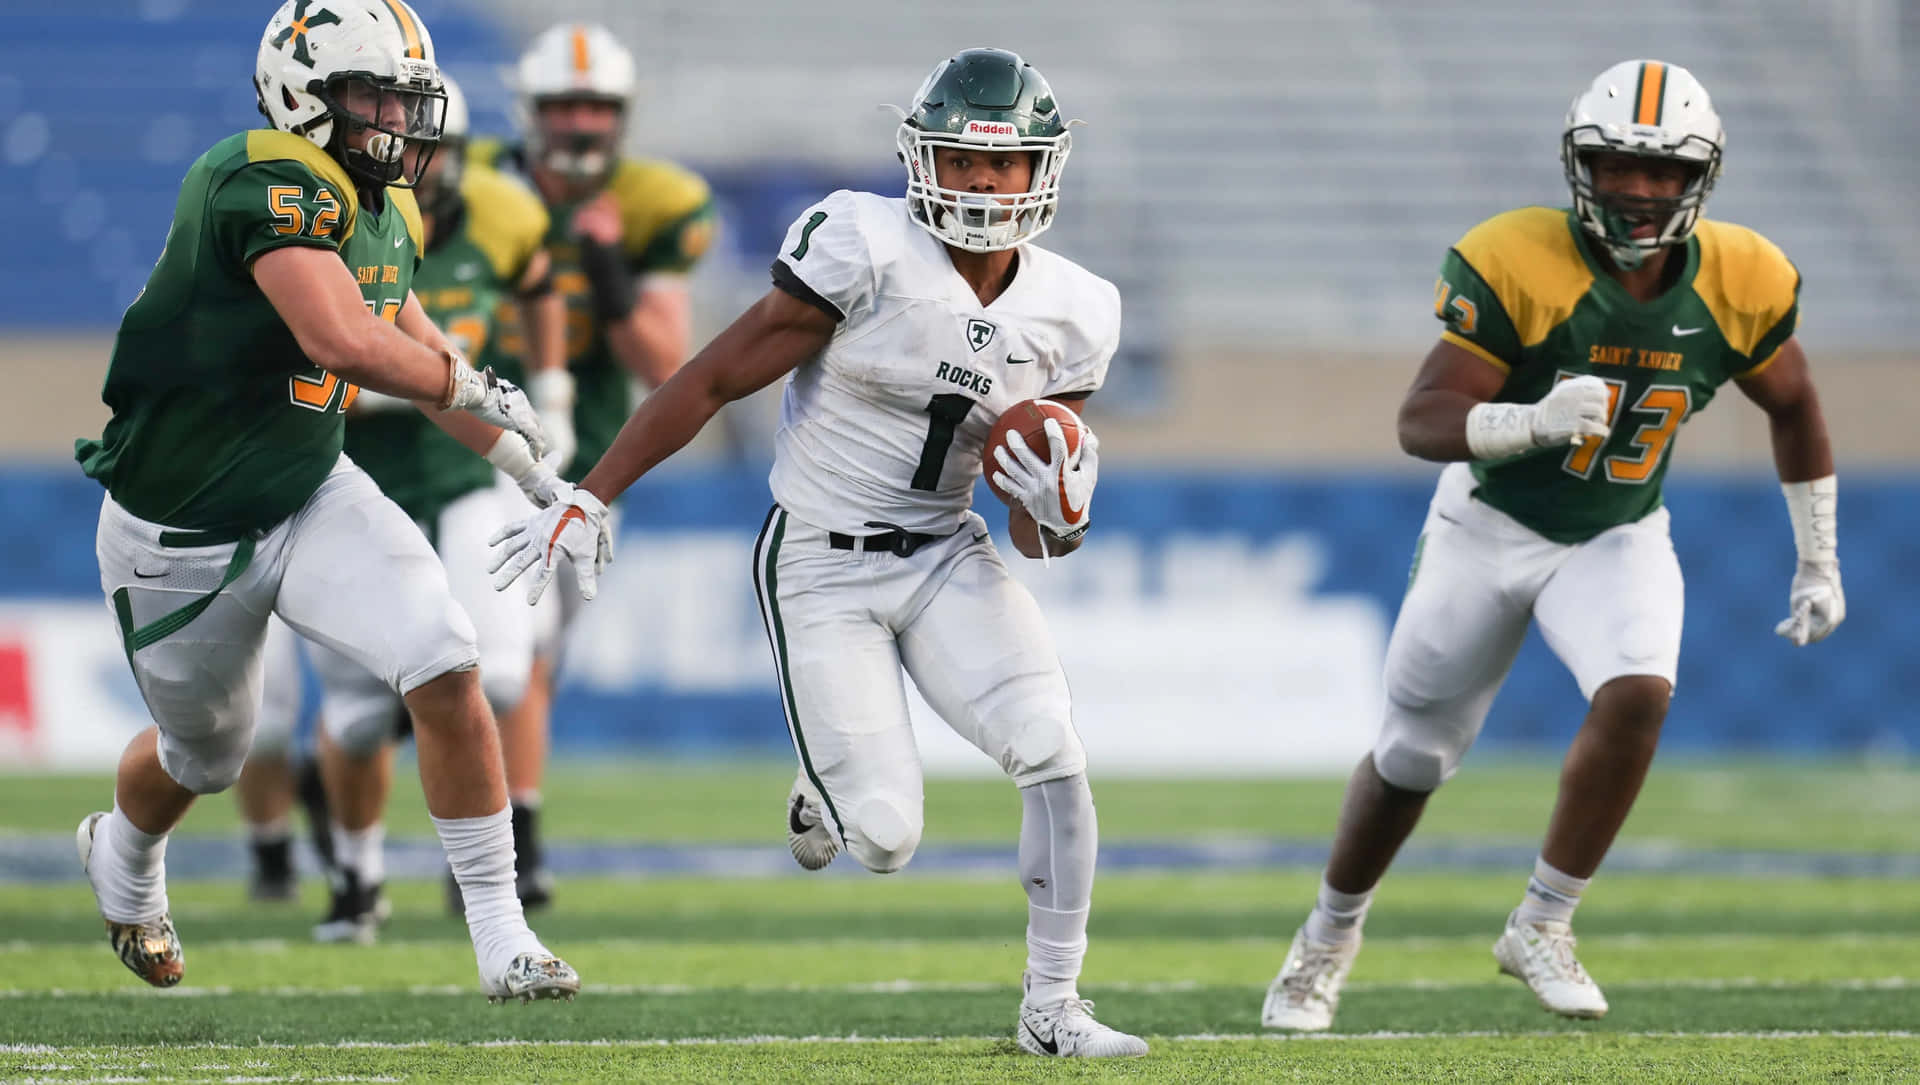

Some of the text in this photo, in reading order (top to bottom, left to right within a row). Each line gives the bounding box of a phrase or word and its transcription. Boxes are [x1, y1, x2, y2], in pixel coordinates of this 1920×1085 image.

[970, 122, 1013, 135] Riddell
[268, 185, 341, 238] 52
[790, 211, 828, 262] 1
[972, 323, 990, 345] T
[1588, 344, 1632, 366] SAINT
[936, 360, 993, 396] ROCKS
[910, 393, 977, 492] 1
